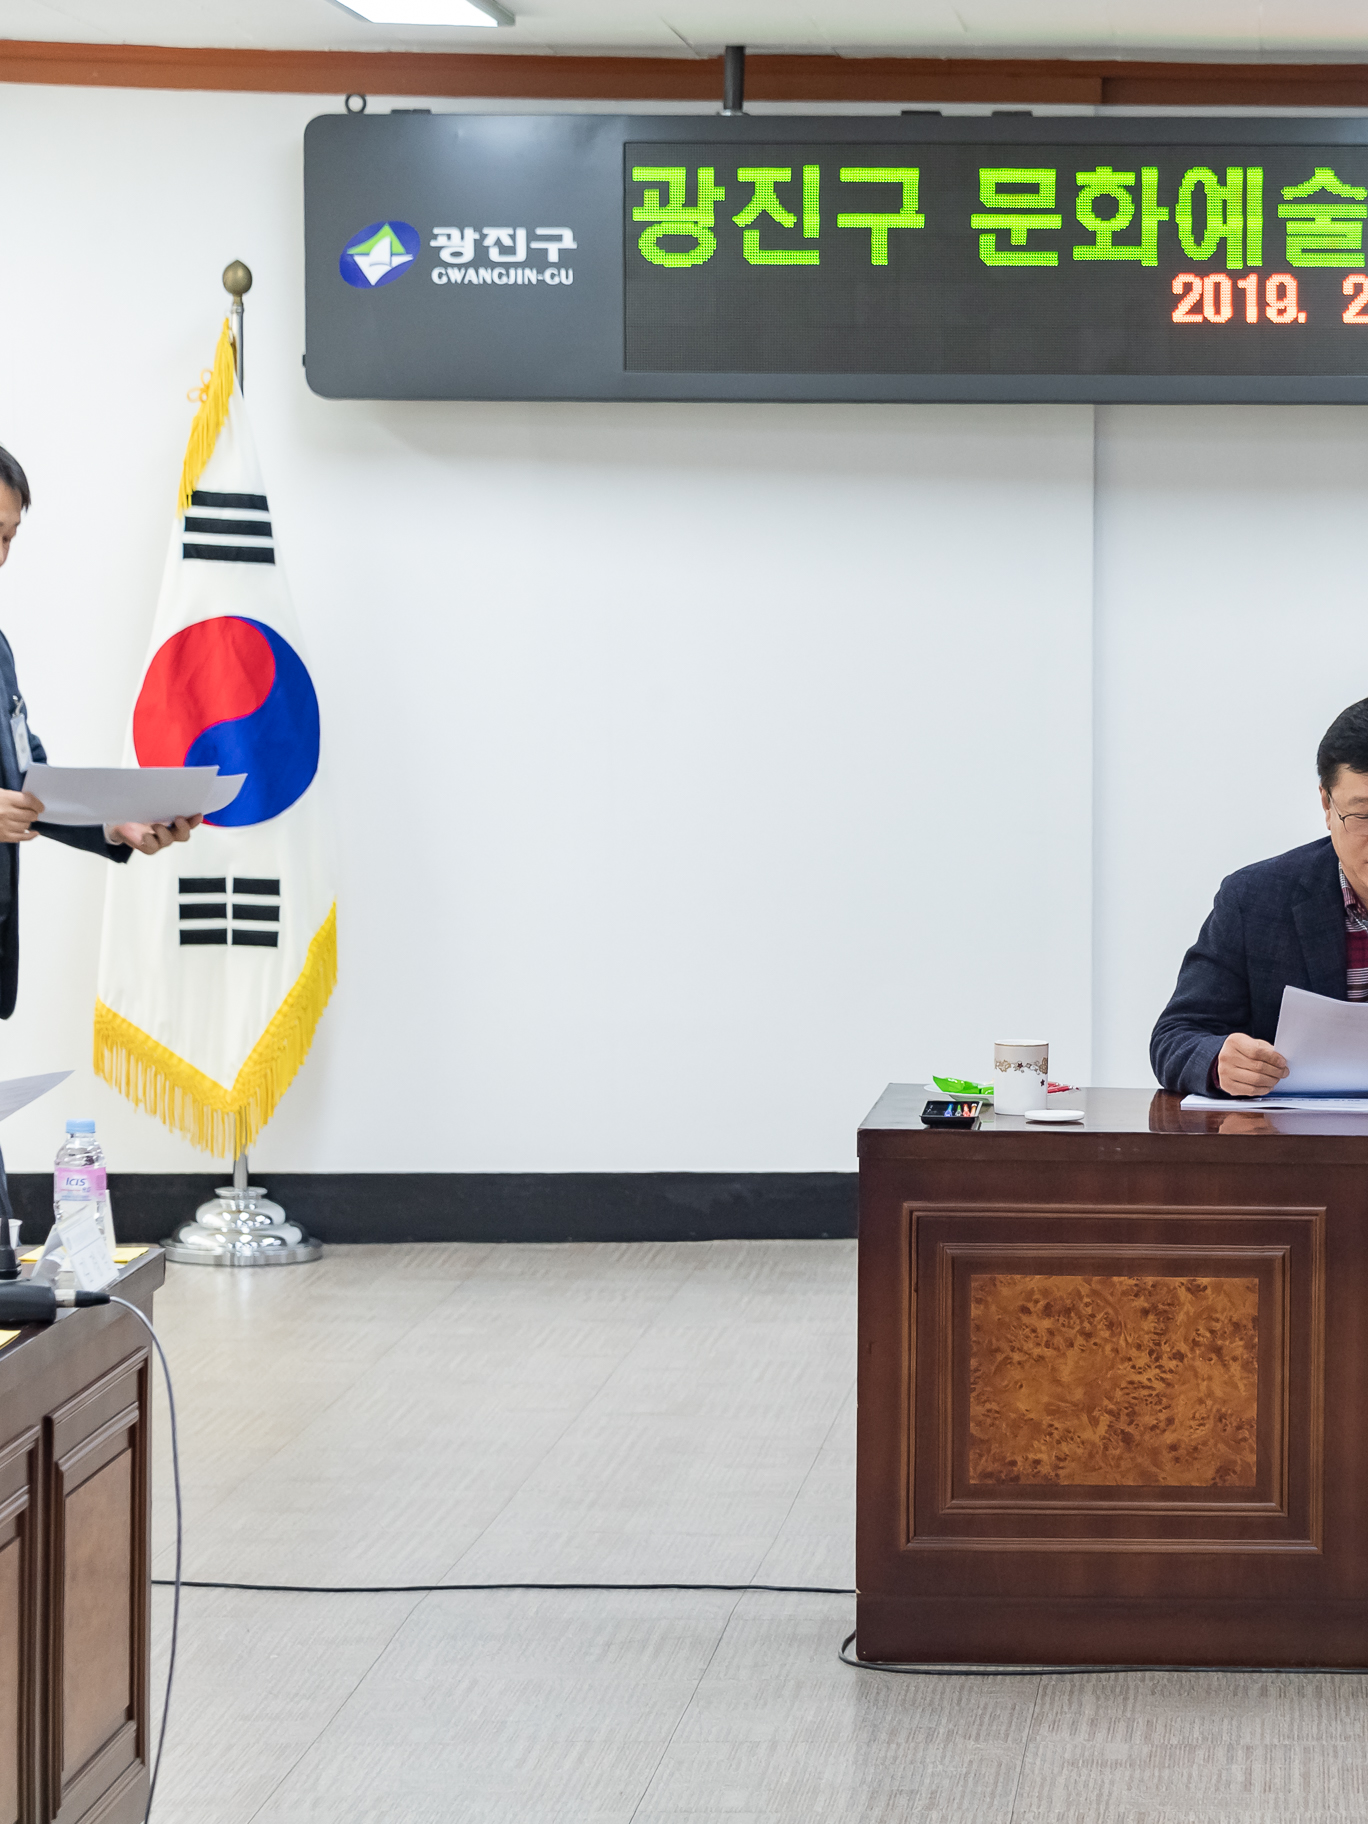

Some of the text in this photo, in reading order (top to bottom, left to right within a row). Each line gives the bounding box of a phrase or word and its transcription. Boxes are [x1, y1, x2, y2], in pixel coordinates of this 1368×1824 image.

[631, 164, 926, 268] 광진구
[429, 226, 578, 264] 광진구
[430, 266, 575, 286] GWANGJIN-GU
[1171, 273, 1308, 324] 2019.
